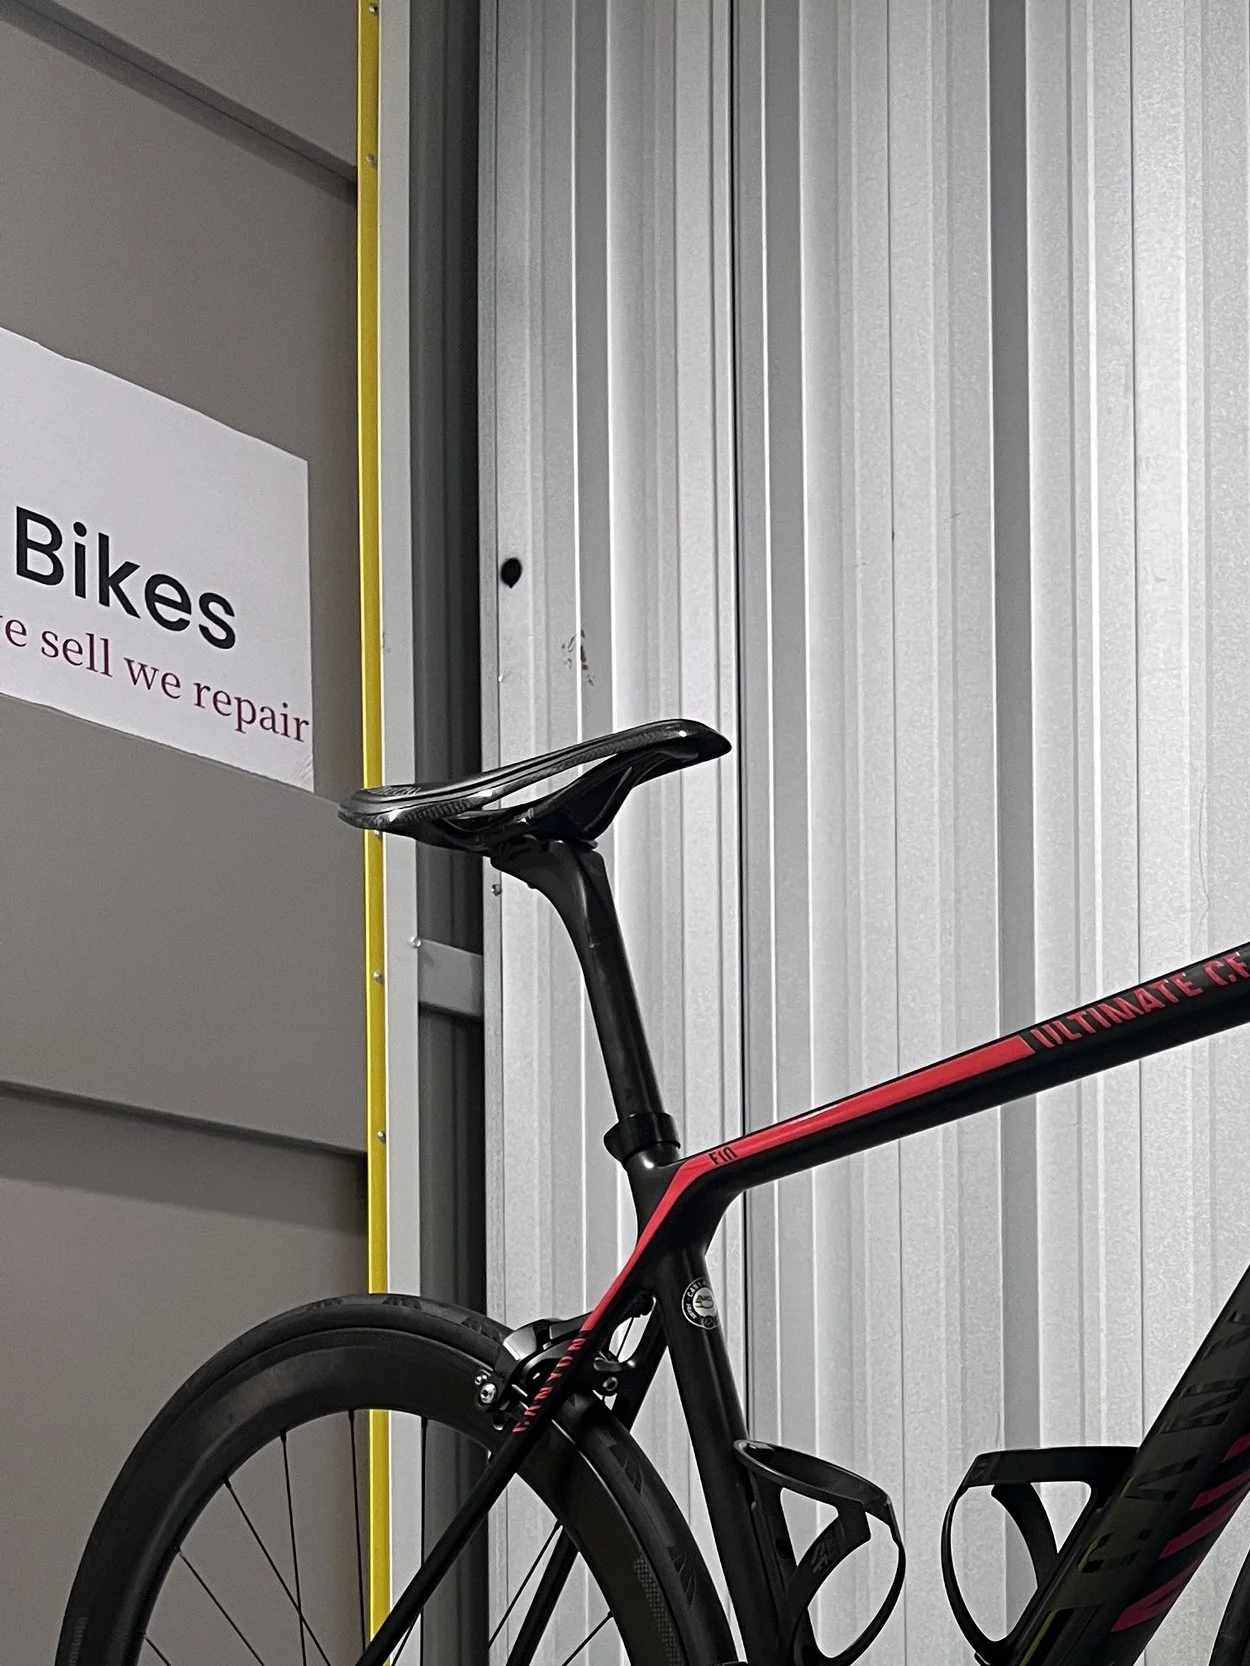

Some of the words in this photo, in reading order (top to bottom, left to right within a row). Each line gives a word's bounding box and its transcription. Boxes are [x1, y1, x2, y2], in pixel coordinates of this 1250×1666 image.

[15, 504, 236, 650] Bikes
[0, 614, 28, 648] e
[40, 630, 113, 678] sell
[123, 656, 181, 700] we
[193, 681, 310, 743] repair
[1030, 971, 1203, 1048] ULTIMATE
